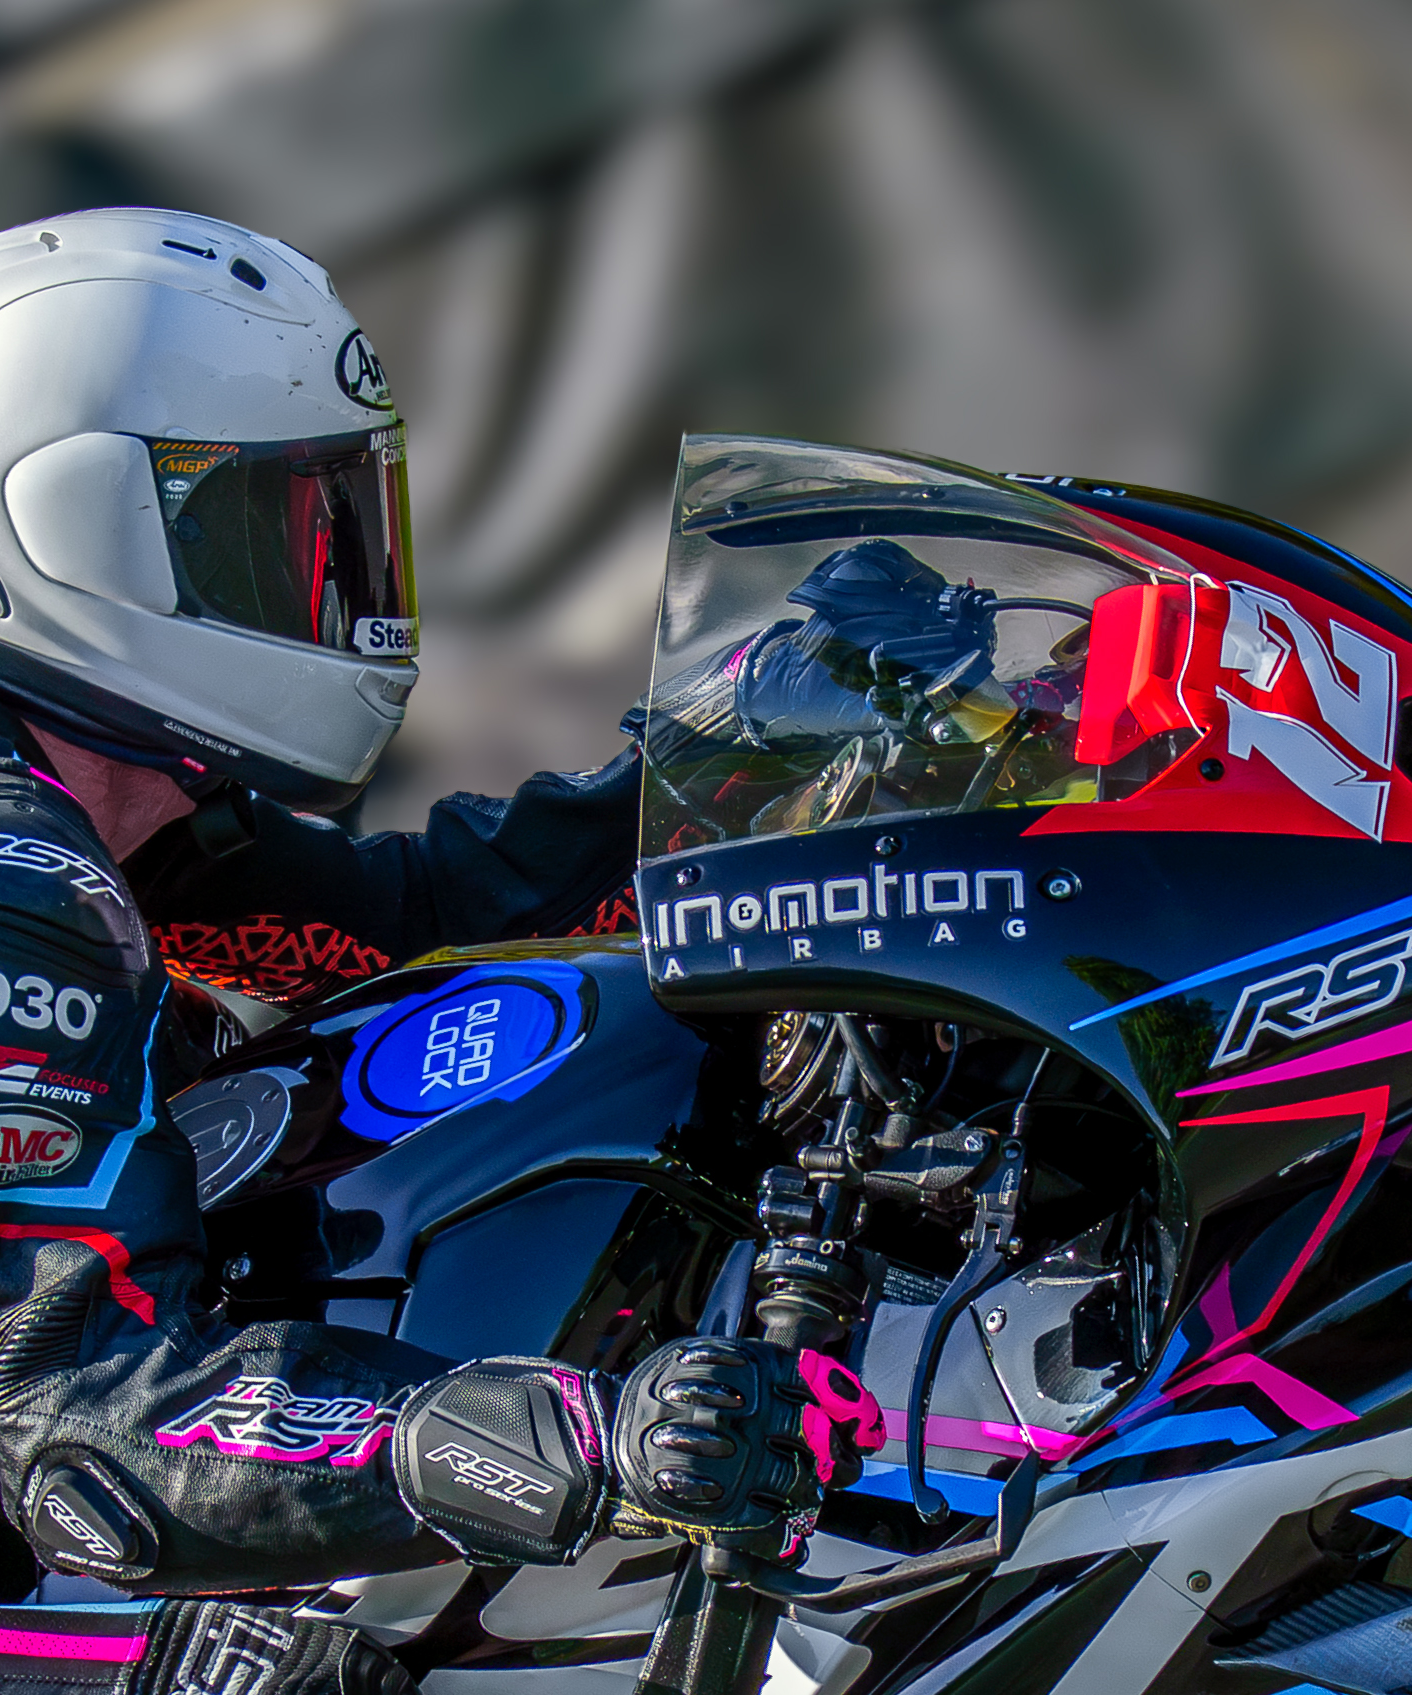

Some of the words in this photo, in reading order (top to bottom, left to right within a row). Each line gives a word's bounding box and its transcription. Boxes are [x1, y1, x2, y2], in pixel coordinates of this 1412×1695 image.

[1216, 579, 1399, 844] 12
[662, 917, 1028, 981] AIRBAG
[419, 1005, 466, 1097] LOCK
[456, 998, 501, 1087] QUAD
[29, 1084, 94, 1105] EVENTS
[38, 1068, 110, 1096] FOCUSED
[425, 1441, 556, 1498] RST
[453, 1475, 484, 1495] pro
[43, 1493, 121, 1560] RST
